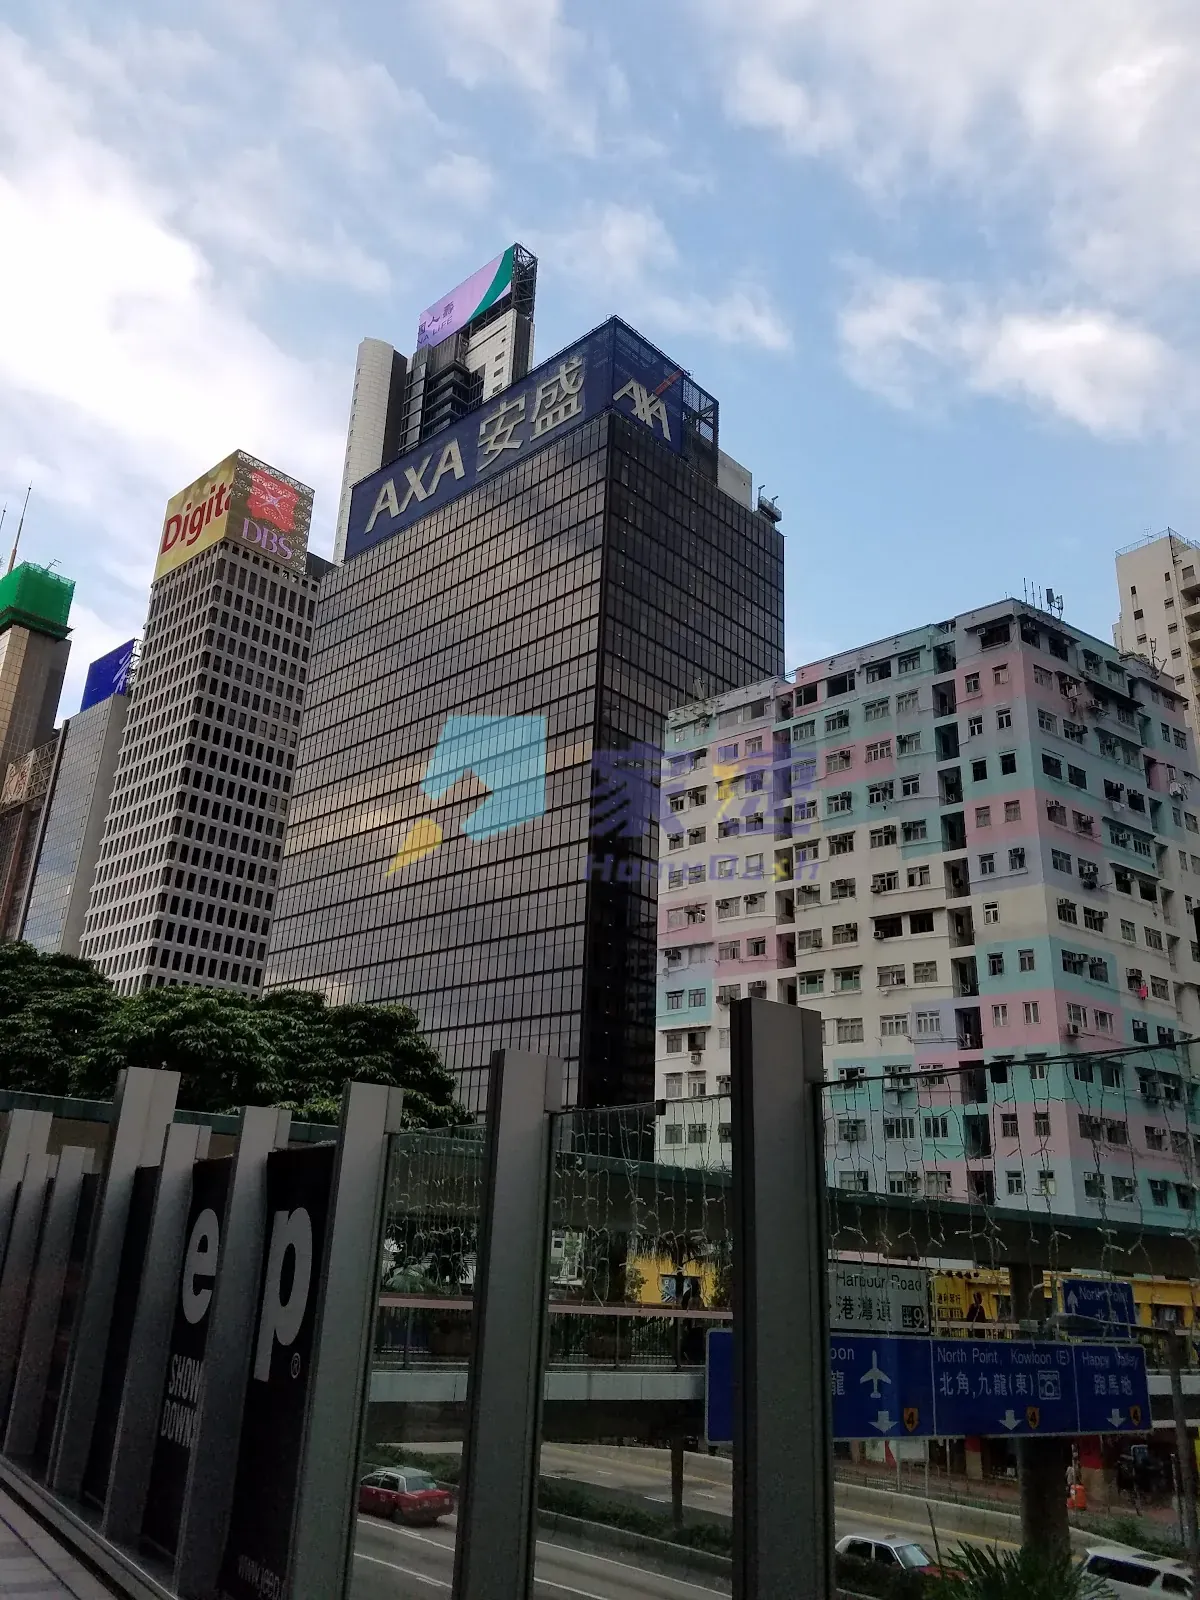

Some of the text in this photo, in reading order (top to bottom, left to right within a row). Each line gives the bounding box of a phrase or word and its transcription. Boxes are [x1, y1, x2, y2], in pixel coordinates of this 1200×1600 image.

[612, 377, 672, 442] AXA
[364, 355, 585, 534] AXA 安盛
[241, 518, 294, 560] DBS
[836, 1271, 922, 1291] Harbour Road
[836, 1295, 892, 1322] 港灣道
[913, 1307, 923, 1327] 9
[937, 1347, 967, 1363] North
[1011, 1349, 1052, 1365] Kowloon
[1055, 1348, 1071, 1366] (E)
[1081, 1351, 1110, 1370] Happy
[1094, 1372, 1133, 1396] 跑馬地
[906, 1411, 915, 1426] 4
[1029, 1411, 1037, 1426] 4
[1132, 1409, 1140, 1423] 4
